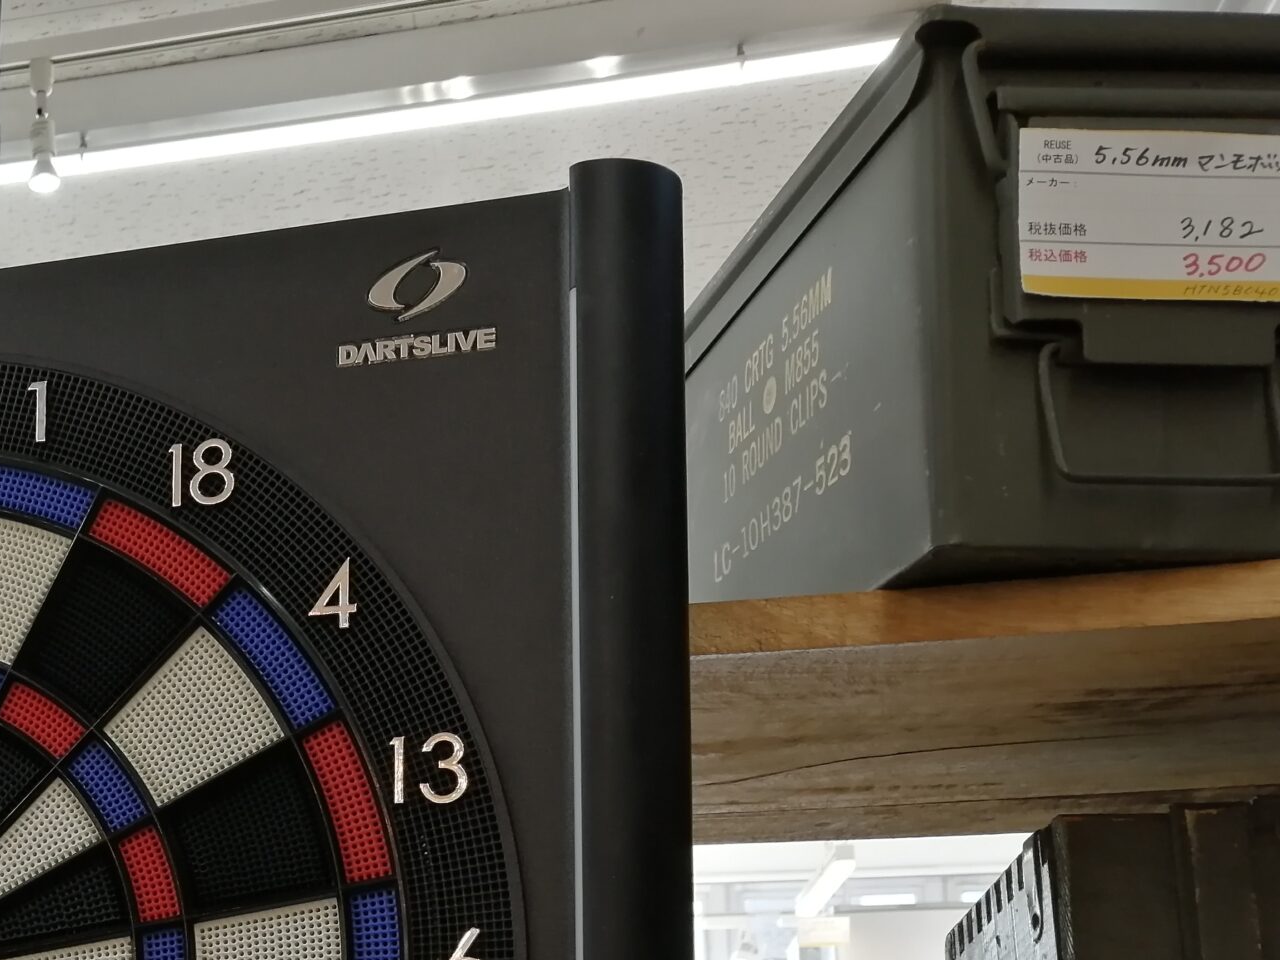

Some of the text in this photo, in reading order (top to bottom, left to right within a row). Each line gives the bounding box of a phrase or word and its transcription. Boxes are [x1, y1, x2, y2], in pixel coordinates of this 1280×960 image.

[1043, 139, 1072, 150] REUSE
[1027, 221, 1087, 237] 税抜価格
[1028, 248, 1088, 263] 税込価格
[337, 327, 496, 367] DARTSLIVE
[744, 333, 774, 394] CRTG
[781, 266, 833, 352] 5.56MM
[27, 380, 48, 442] 1
[728, 330, 819, 454] BALL M855
[168, 437, 235, 507] 18
[723, 464, 735, 503] 10
[742, 416, 782, 485] ROUND
[308, 557, 357, 628] 4
[389, 731, 469, 804] 13
